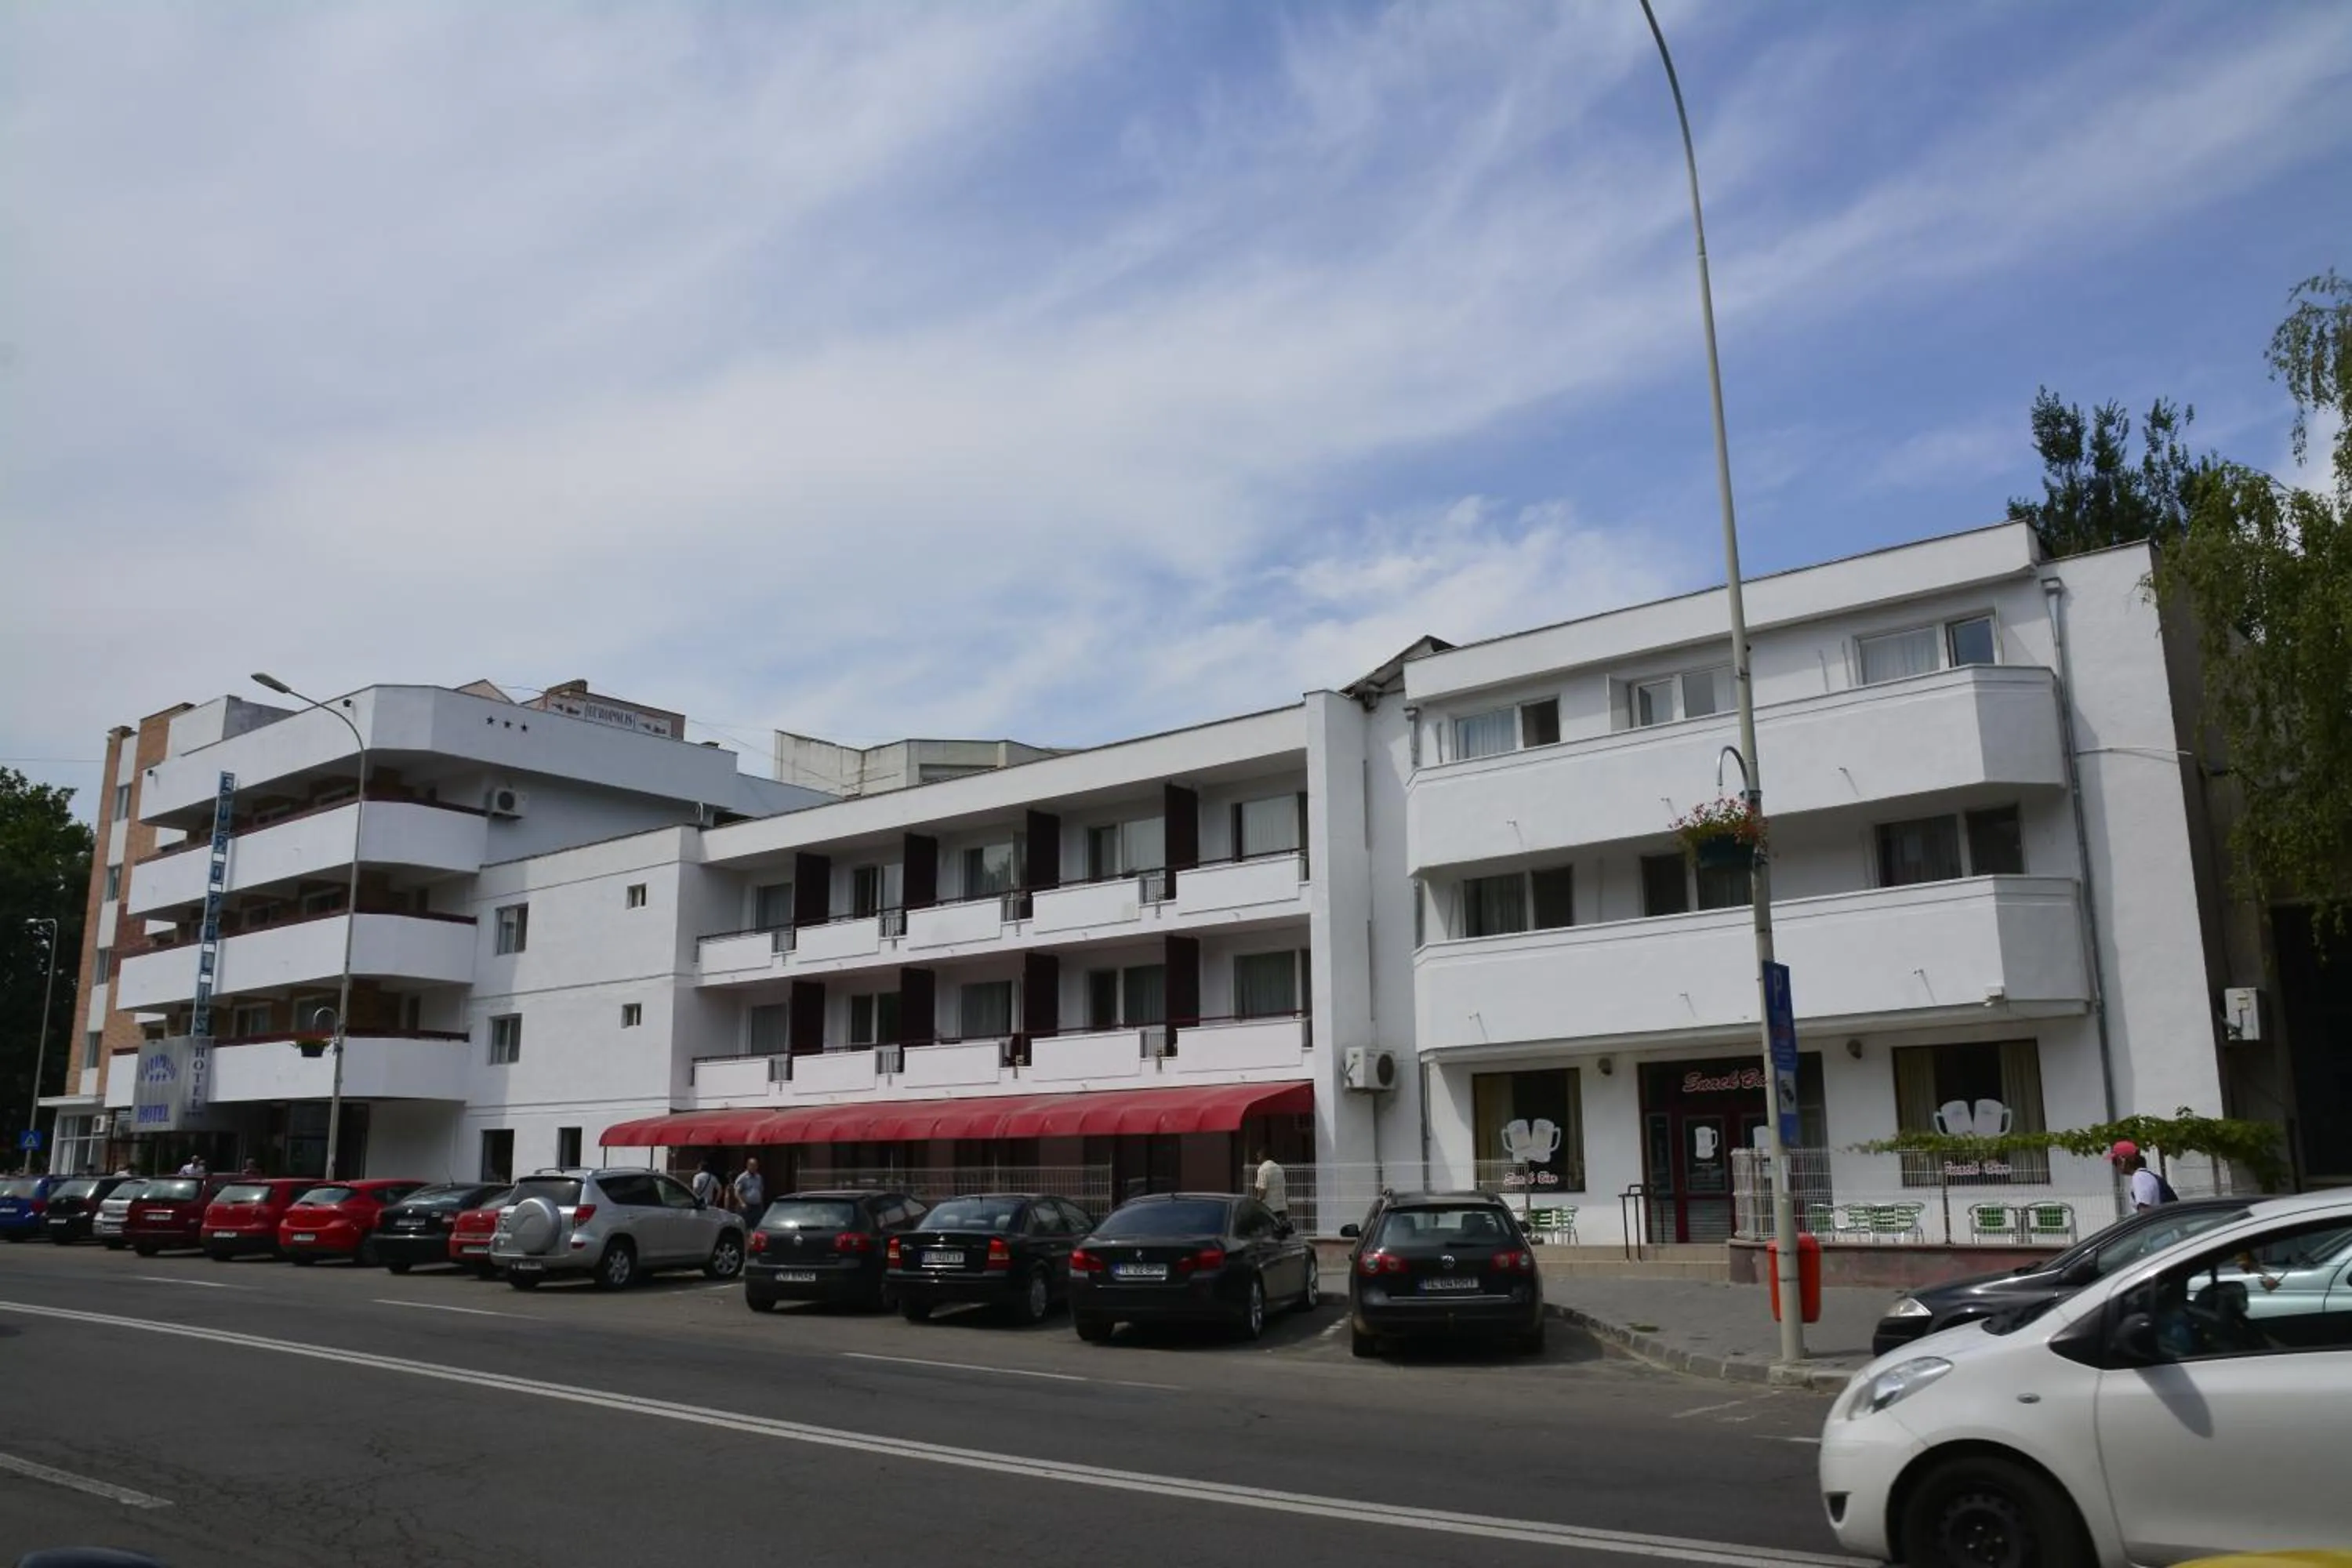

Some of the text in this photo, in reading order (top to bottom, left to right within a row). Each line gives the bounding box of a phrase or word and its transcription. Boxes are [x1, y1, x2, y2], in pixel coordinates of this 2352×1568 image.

[191, 1047, 205, 1111] HOTEL
[1682, 1067, 1767, 1093] Snack Ba
[137, 1103, 170, 1123] HOTEL
